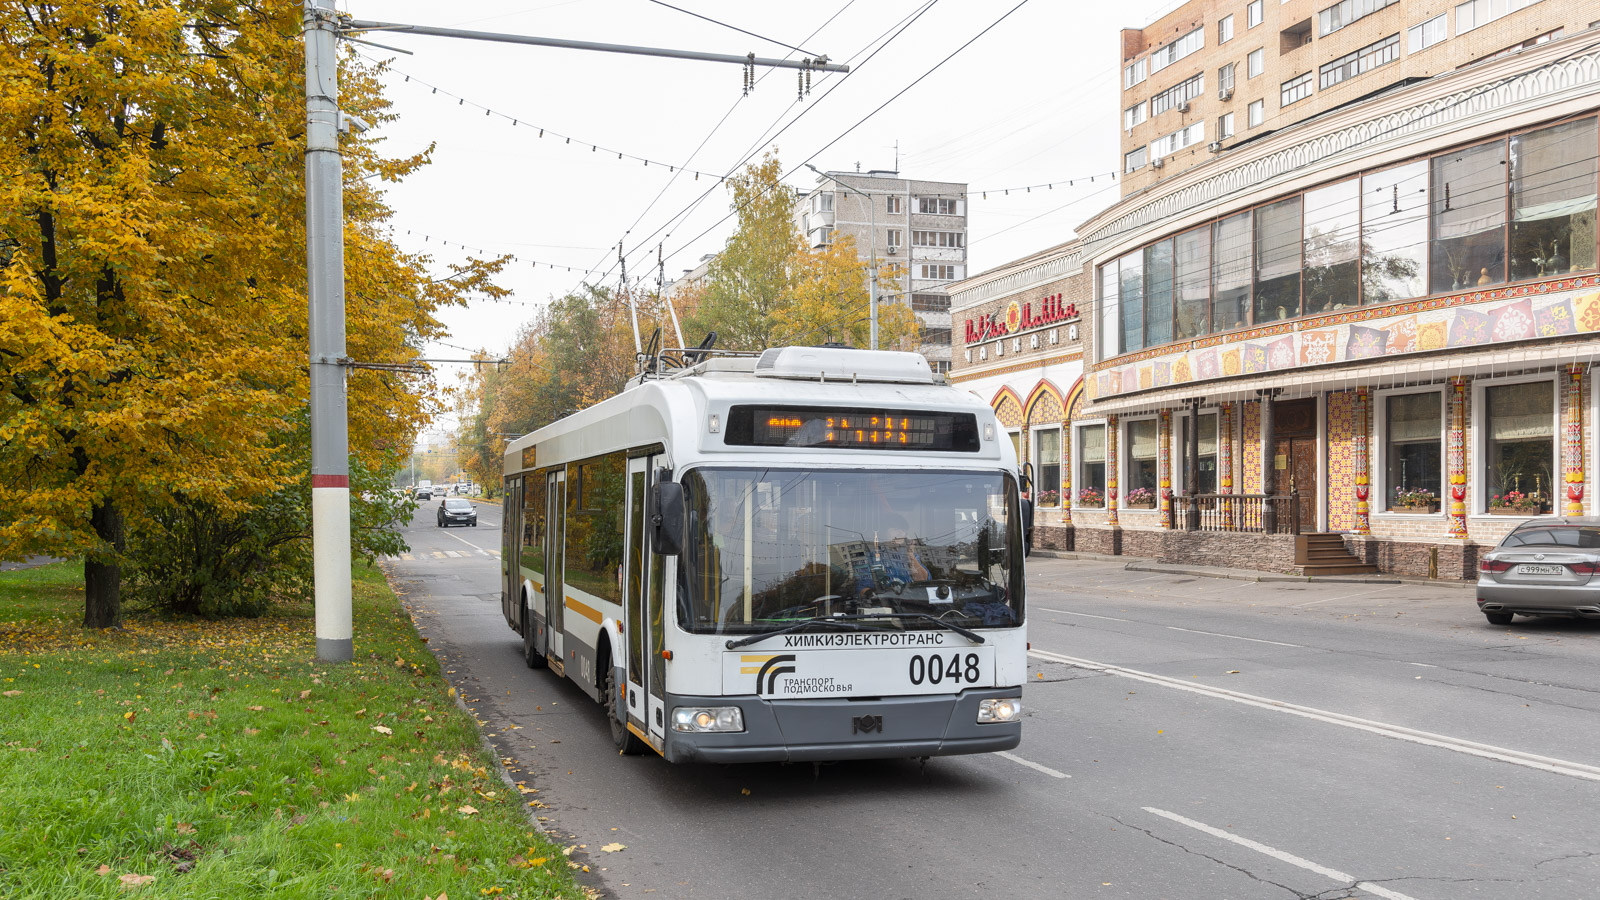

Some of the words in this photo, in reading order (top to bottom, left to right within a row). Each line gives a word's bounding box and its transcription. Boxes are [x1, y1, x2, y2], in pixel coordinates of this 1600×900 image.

[965, 324, 1079, 363] ЧАЙХАНА
[784, 633, 943, 647] ХИМКИЭЛЕКТРОТРАНС
[909, 653, 981, 686] 0048
[784, 677, 834, 686] ТРАНСПОРТ
[784, 684, 853, 694] ПОДМОСКОВЬЯ
